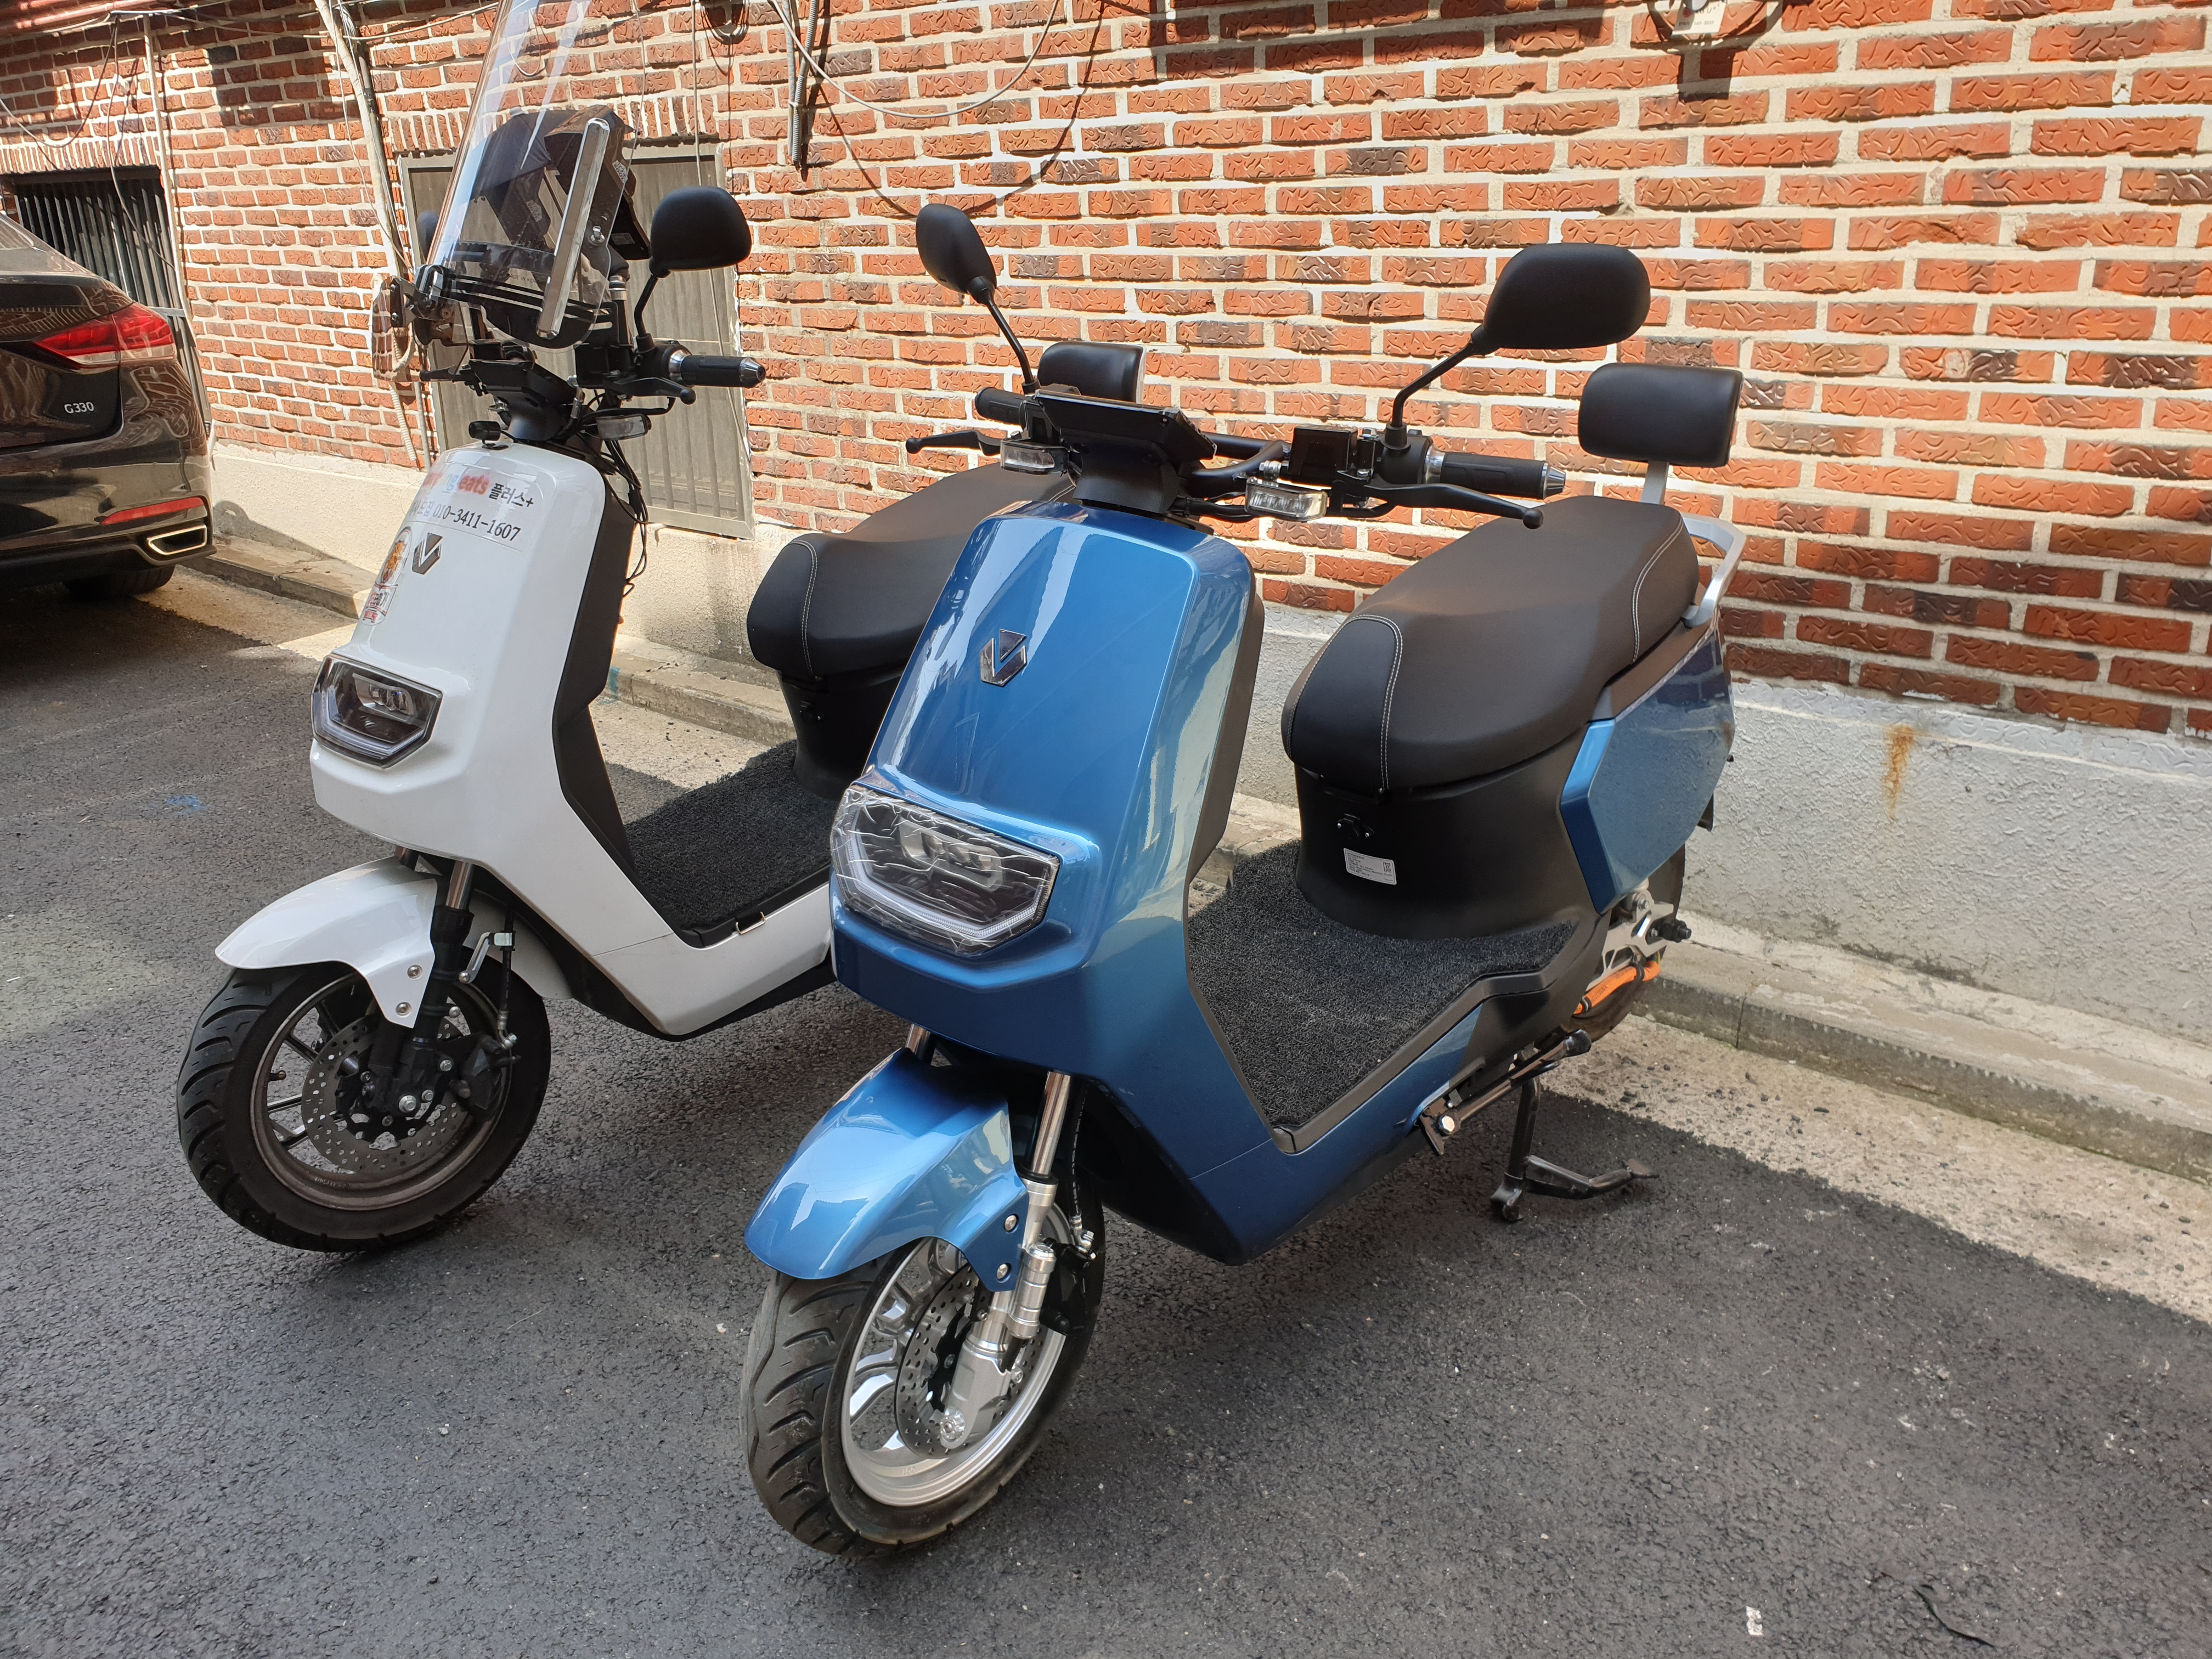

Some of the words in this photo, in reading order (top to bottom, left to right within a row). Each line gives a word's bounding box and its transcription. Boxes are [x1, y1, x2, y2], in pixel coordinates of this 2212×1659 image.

[64, 401, 94, 414] G330
[458, 474, 489, 495] eats
[433, 503, 521, 541] 010-3411-1607
